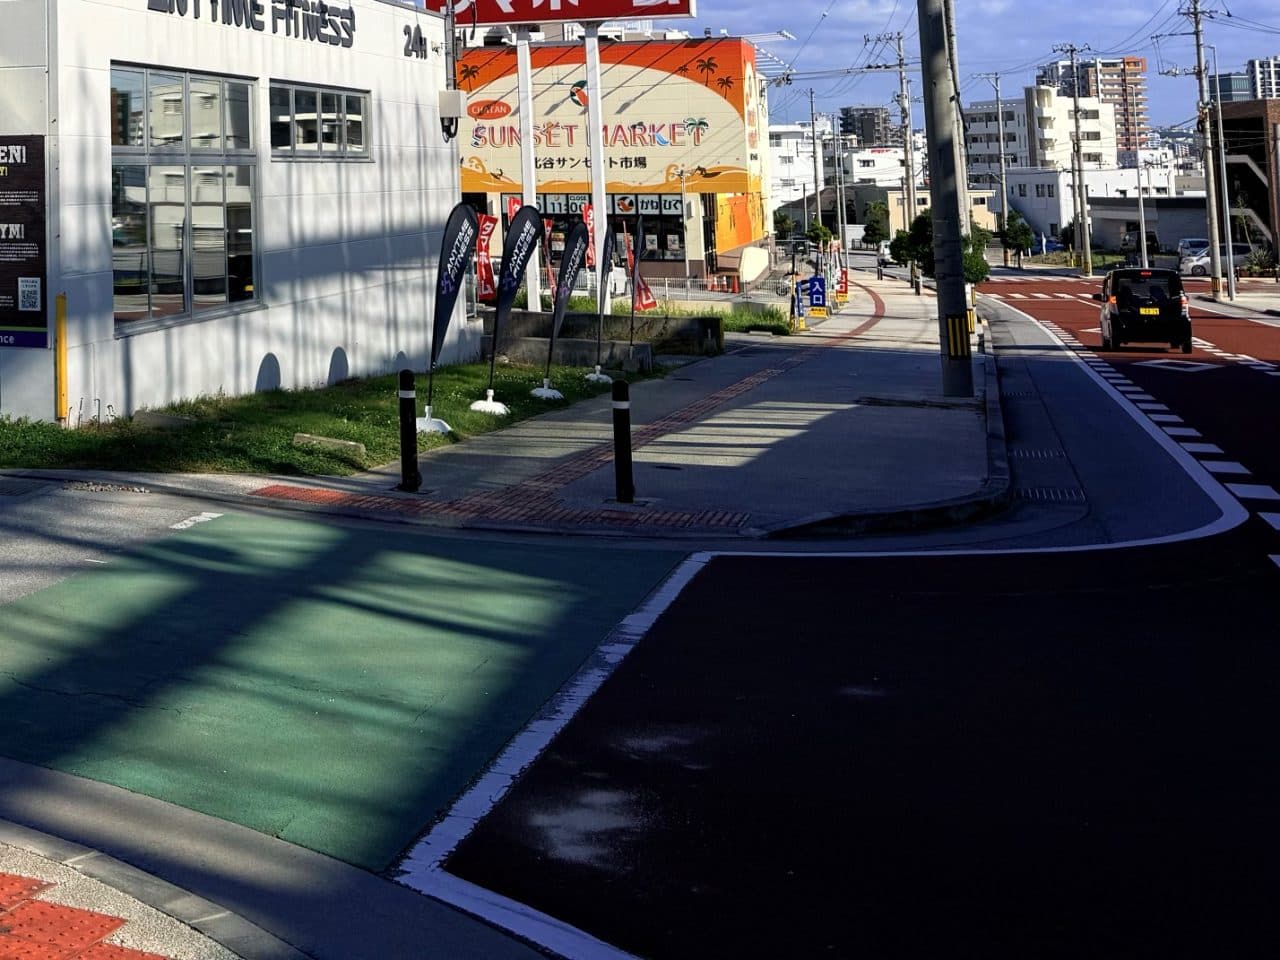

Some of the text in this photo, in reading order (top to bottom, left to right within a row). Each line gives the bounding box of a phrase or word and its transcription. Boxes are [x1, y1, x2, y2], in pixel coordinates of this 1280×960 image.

[587, 123, 703, 147] ARKET
[535, 156, 647, 169] 北谷サンセト市場
[447, 218, 474, 282] ANYTIME FITNESS
[509, 219, 532, 272] ANYTIME
[812, 281, 823, 304] 入口
